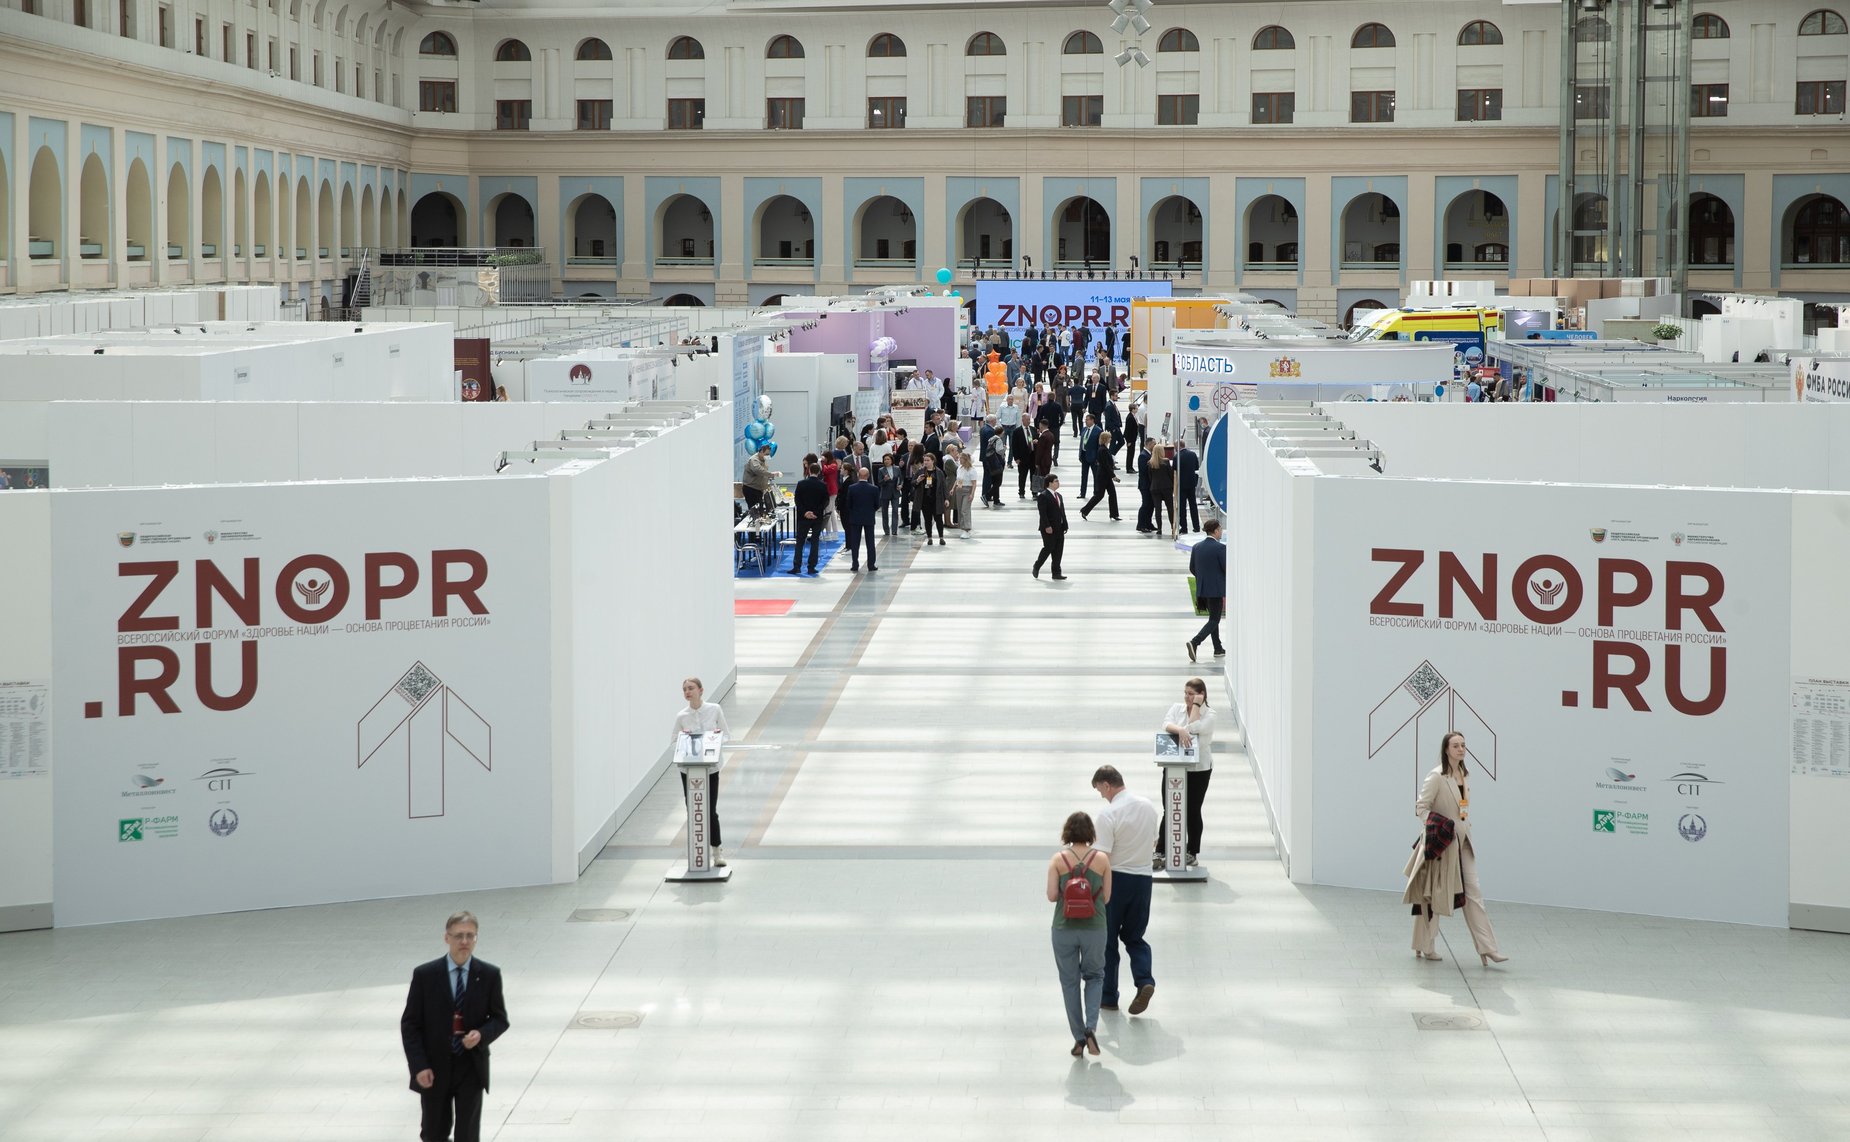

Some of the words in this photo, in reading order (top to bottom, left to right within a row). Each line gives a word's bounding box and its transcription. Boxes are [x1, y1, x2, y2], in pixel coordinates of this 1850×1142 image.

[997, 304, 1129, 327] ZNOPR.R
[1181, 356, 1233, 373] ОБЛАСТЬ
[1667, 394, 1708, 402] Наркология
[1806, 372, 1826, 392] ФМБА
[1827, 374, 1850, 398] РОССИ
[117, 548, 490, 633] ZNOPR
[1369, 547, 1727, 634] ZNOPR
[117, 630, 200, 645] ВСЕРОССИЙСКИЙ
[203, 629, 239, 640] ФОРУМ
[241, 626, 294, 640] «ЗДОРОВЬЕ
[297, 624, 329, 636] НАЦИИ
[346, 621, 383, 633] ОСНОВА
[385, 618, 449, 632] ПРОЦВЕТАНИЯ
[451, 616, 491, 628] РОССИИ»
[1369, 616, 1442, 630] ВСЕРОССИЙСКИЙ
[1444, 620, 1477, 632] ФОРУМ
[1479, 622, 1529, 635] «ЗДОРОВЬЕ
[1531, 625, 1562, 637] НАЦИИ
[1578, 627, 1615, 638] ОСНОВА
[1617, 629, 1683, 642] ПРОЦВЕТАНИЯ
[1685, 632, 1727, 645] РОССИИ»
[84, 640, 258, 718] .RU
[1562, 640, 1727, 716] .RU
[121, 788, 177, 797] Металлоинвест
[1595, 782, 1648, 792] Металлоинвест
[144, 815, 179, 824] Р-ФАРМ
[1616, 811, 1649, 820] Р-ФАРМ
[694, 792, 704, 868] ЗНОПР.РФ
[1172, 792, 1182, 867] ЗНОПР.РФ
